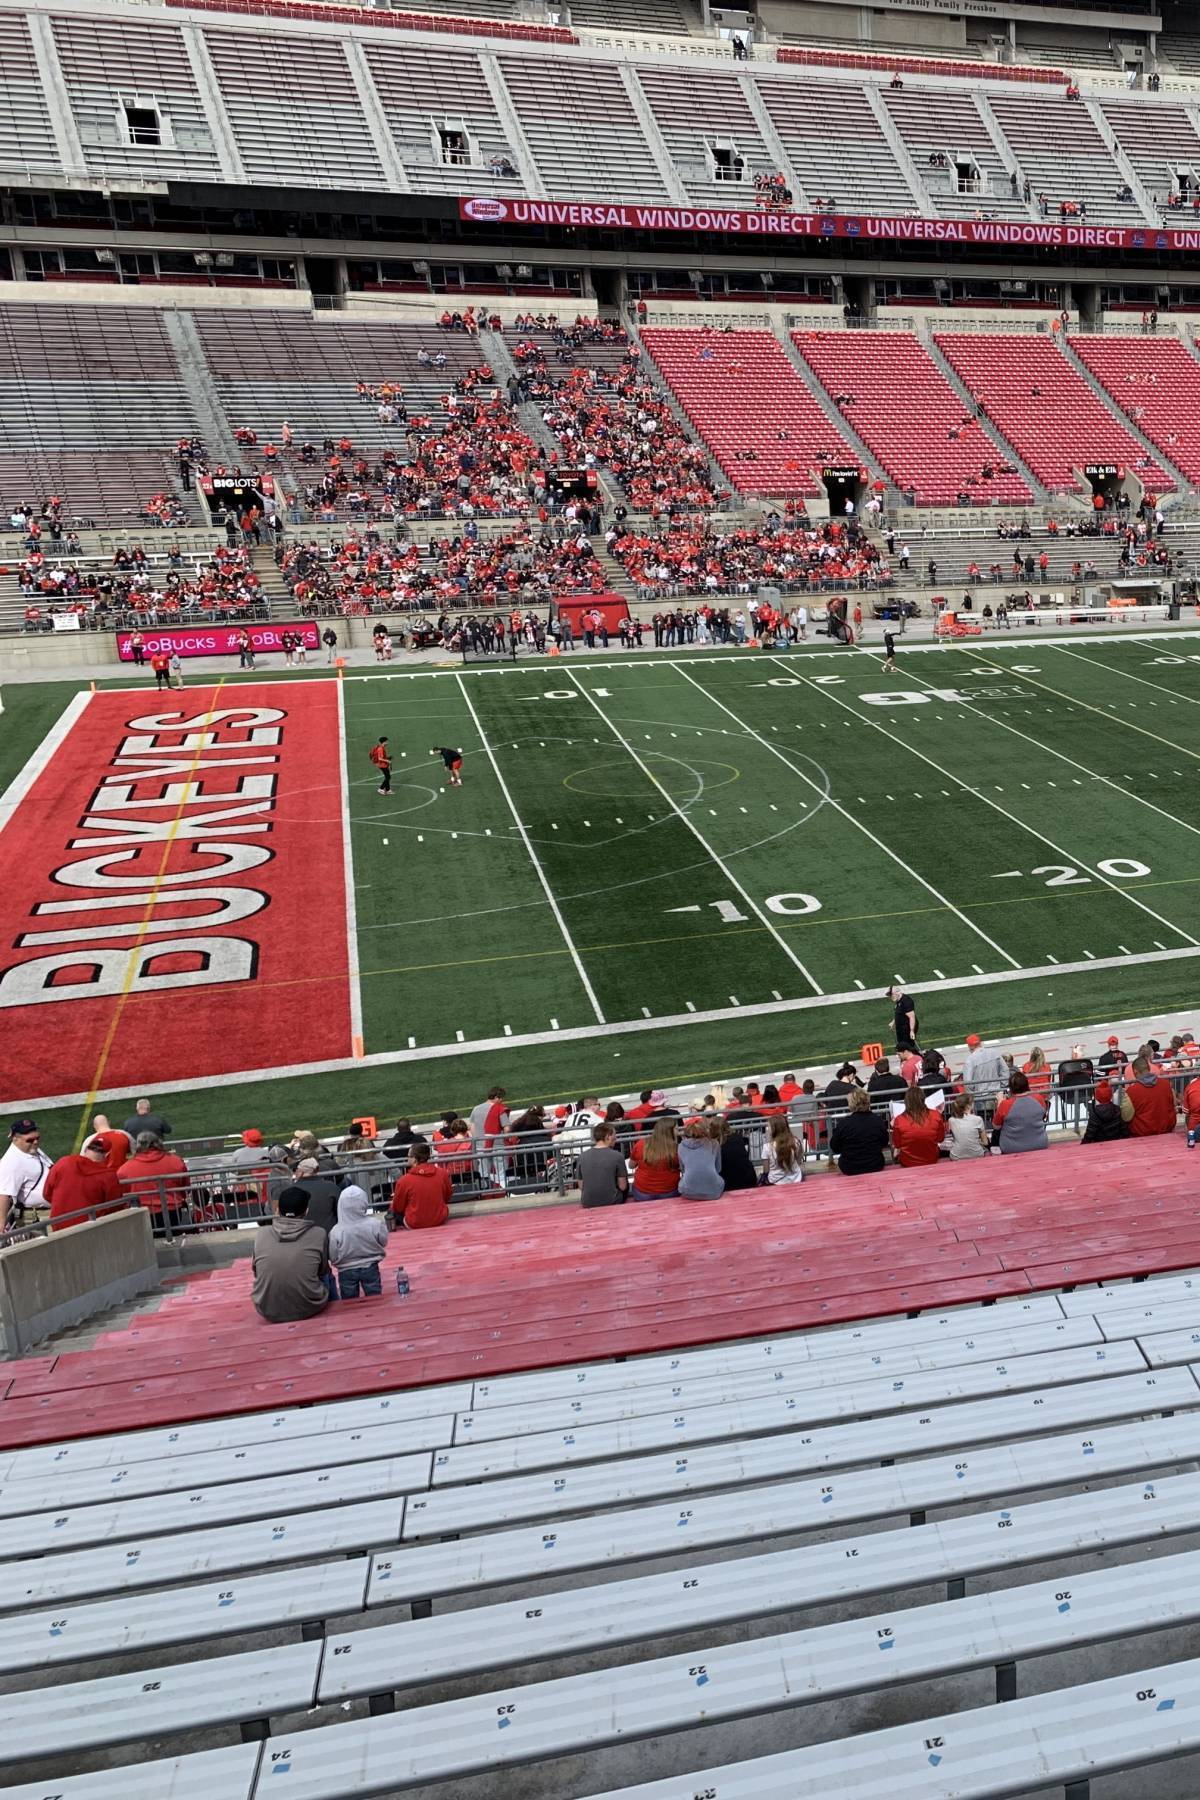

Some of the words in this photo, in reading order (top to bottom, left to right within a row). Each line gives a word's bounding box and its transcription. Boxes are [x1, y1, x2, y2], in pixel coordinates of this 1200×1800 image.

[513, 202, 631, 226] UNIVERSAL
[636, 210, 741, 231] WINDOWS
[746, 213, 814, 233] DIRECT
[866, 219, 967, 240] UNIVERSAL
[972, 224, 1061, 244] WINDOWS
[1067, 227, 1126, 246] DIRECT
[1086, 466, 1097, 474] Elk
[1105, 466, 1117, 474] Elk
[767, 676, 847, 687] 20
[543, 687, 615, 701] 10
[0, 705, 288, 1008] BUCKEYES
[1029, 857, 1152, 888] 20
[705, 891, 823, 923] 10
[866, 1046, 880, 1062] 10
[572, 1113, 591, 1126] 16
[376, 1563, 391, 1571] 24
[684, 1580, 698, 1588] 22
[1055, 1592, 1071, 1600] 20
[526, 1610, 541, 1618] 23
[878, 1628, 892, 1637] 21
[335, 1646, 351, 1655] 24
[689, 1666, 706, 1675] 22
[143, 1682, 160, 1691] 25
[1137, 1689, 1156, 1700] 20
[497, 1705, 515, 1715] 23
[926, 1737, 943, 1749] 21
[272, 1750, 291, 1761] 24
